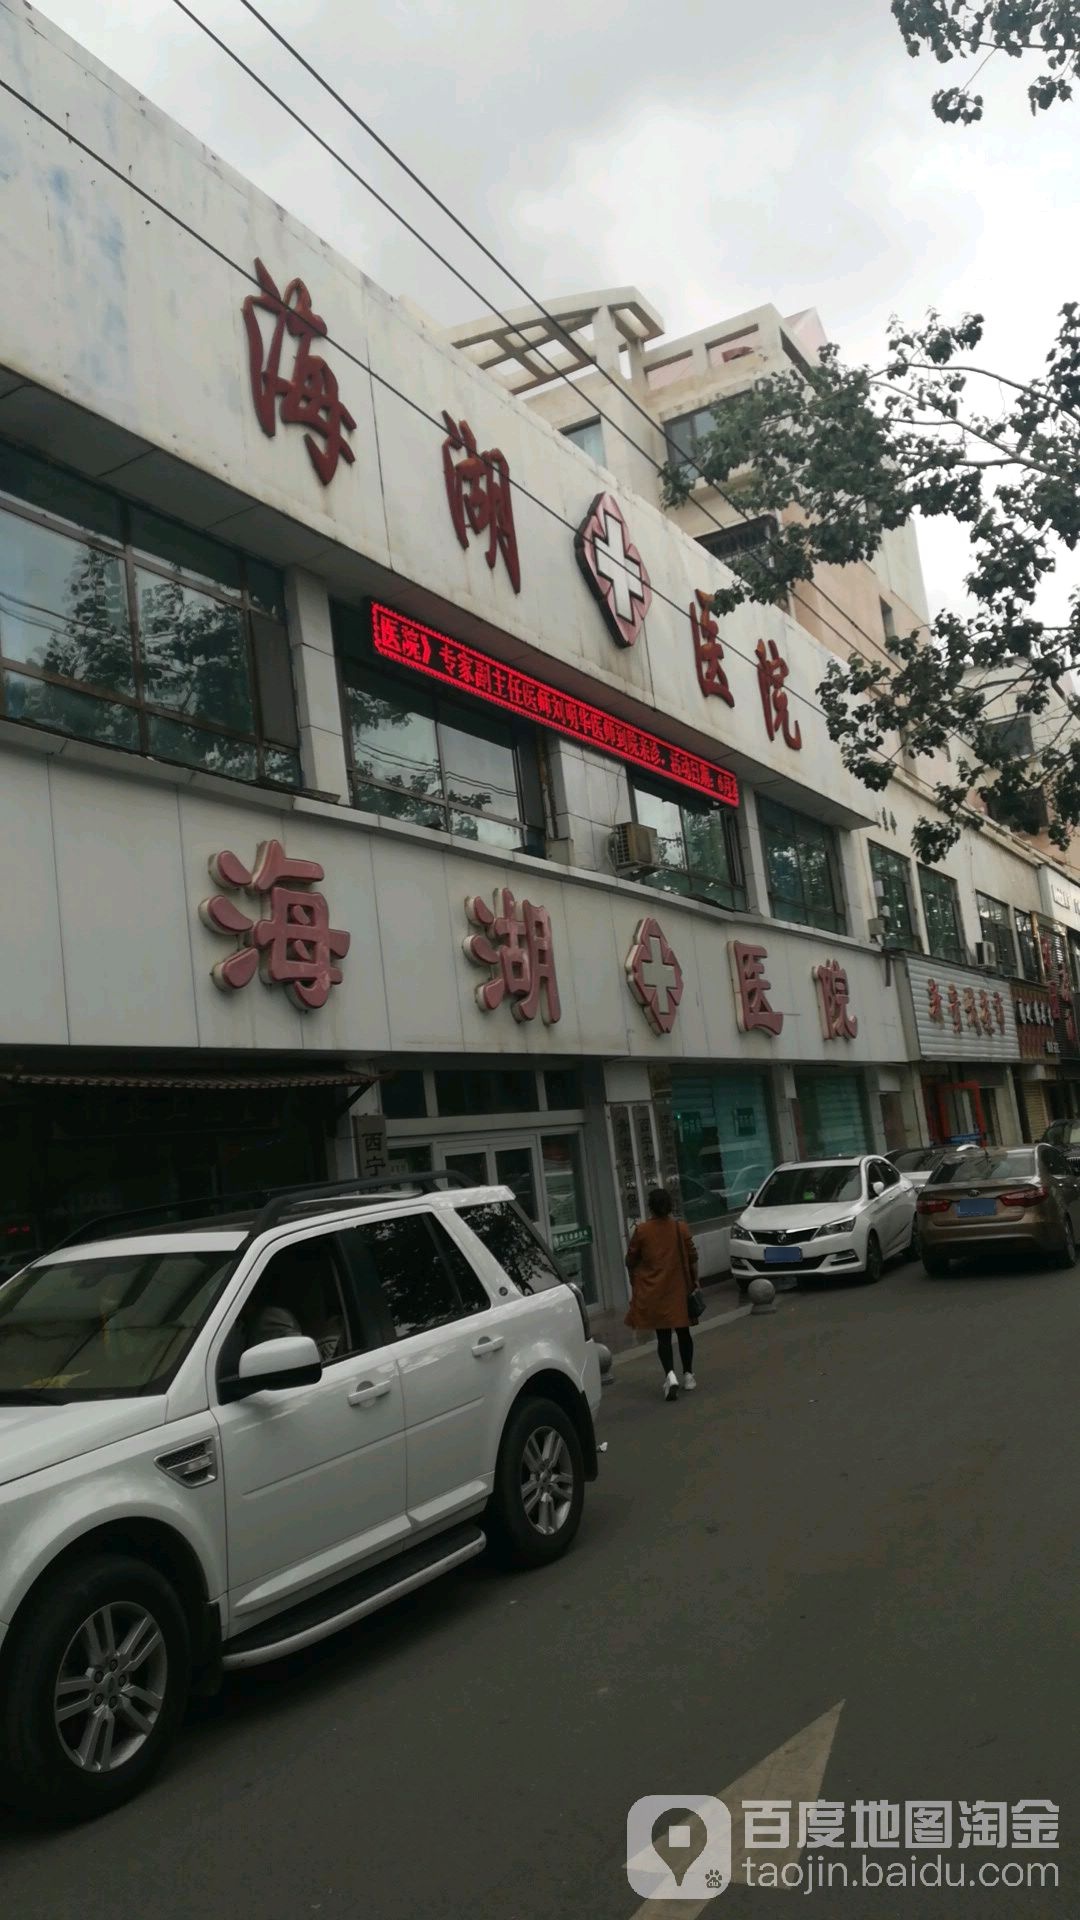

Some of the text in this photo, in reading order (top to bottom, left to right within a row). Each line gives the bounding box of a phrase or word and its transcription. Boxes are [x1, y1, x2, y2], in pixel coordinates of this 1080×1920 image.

[243, 257, 803, 751] 海湖医院
[199, 839, 859, 1040] 海湖医院
